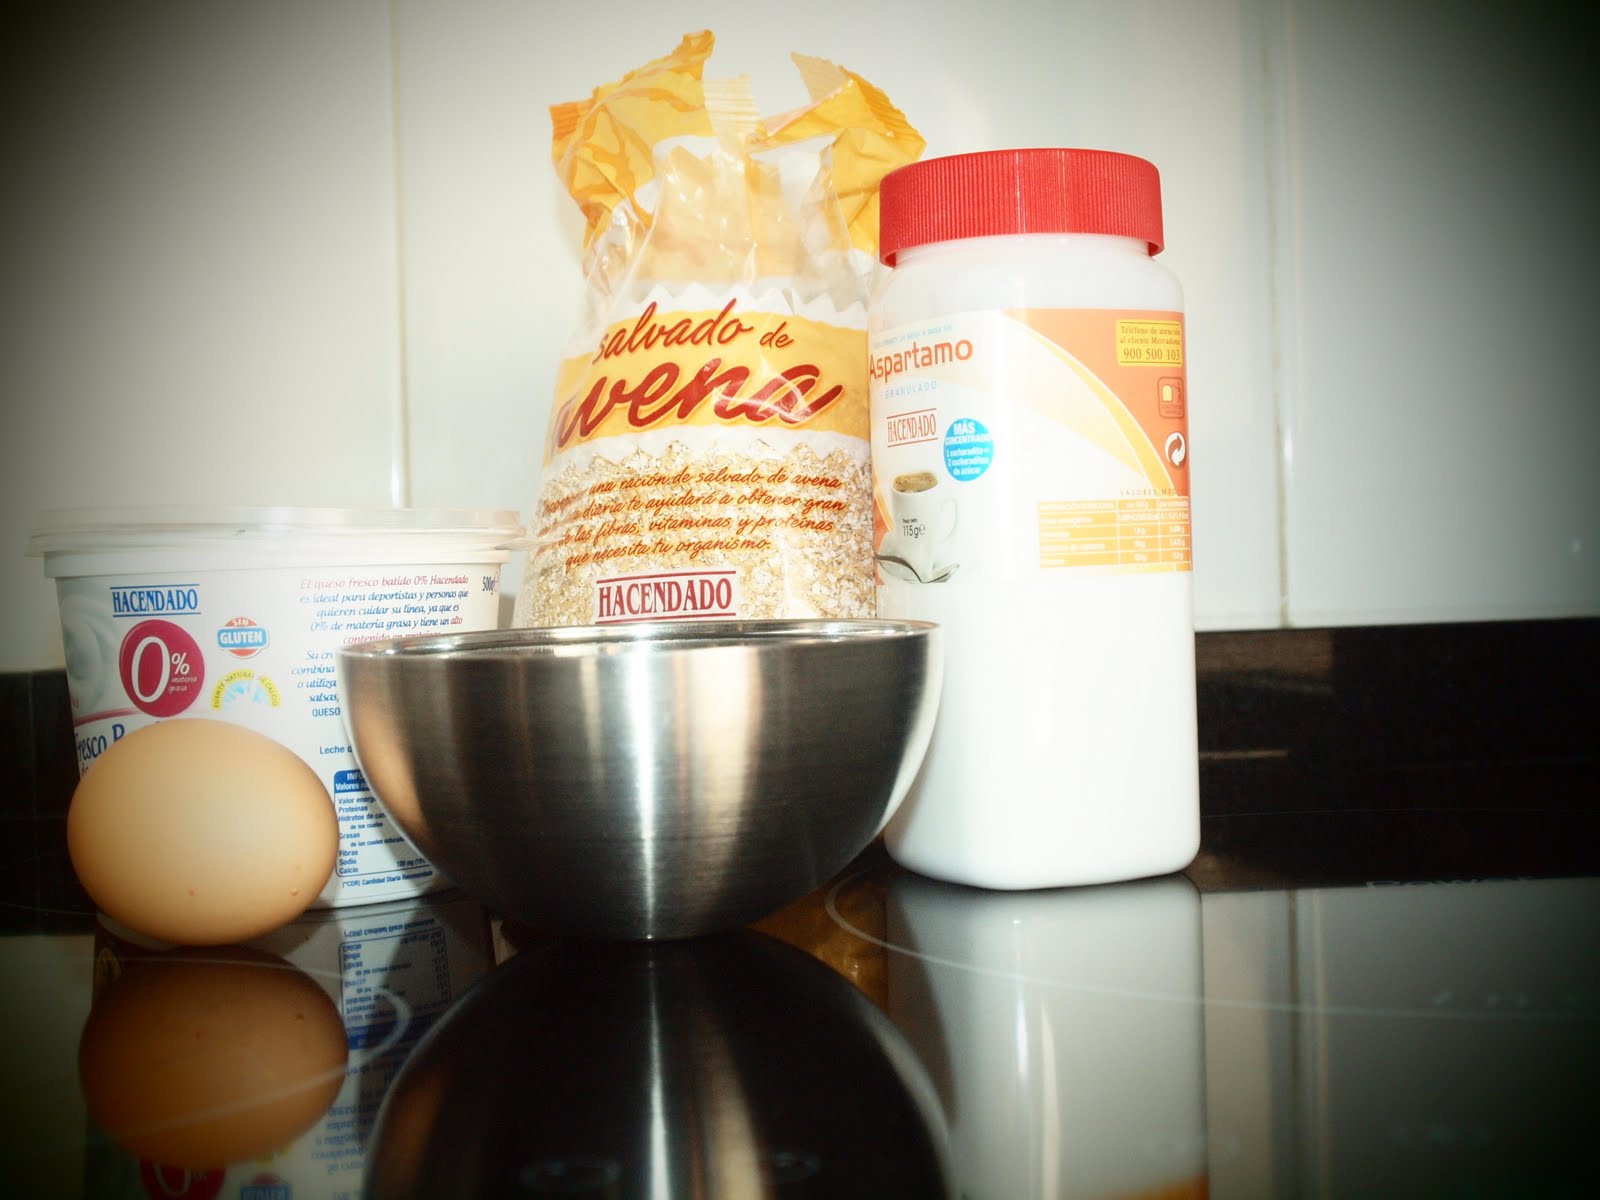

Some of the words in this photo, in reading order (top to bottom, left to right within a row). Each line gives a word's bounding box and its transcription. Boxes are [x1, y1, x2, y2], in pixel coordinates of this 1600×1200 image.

[593, 298, 754, 365] salvado
[759, 321, 794, 349] de
[870, 339, 973, 383] Aspartamo
[1123, 348, 1141, 359] 900
[1145, 348, 1162, 360] 500
[1167, 349, 1180, 361] 103
[885, 381, 937, 399] GRANULADO
[887, 413, 936, 443] HACENDADO
[954, 420, 976, 435] MÁS
[589, 482, 615, 495] una
[620, 473, 669, 490] ración
[672, 466, 692, 484] de
[695, 466, 762, 484] salvado
[767, 467, 788, 483] de
[790, 474, 842, 489] avena
[583, 501, 624, 519] diaria
[628, 496, 643, 510] te
[645, 489, 717, 515] ayudará
[719, 494, 732, 505] a
[802, 499, 846, 515] gran
[574, 525, 591, 542] las
[593, 519, 639, 546] fibras,
[649, 514, 731, 531] vitaminas
[736, 519, 750, 535] y
[565, 553, 591, 573] que
[593, 542, 650, 561] necesita
[652, 540, 673, 553] tu
[675, 537, 771, 560] organismo.
[314, 579, 345, 591] queso
[348, 577, 379, 589] fresco
[382, 576, 411, 586] batido
[414, 576, 428, 585] 0%
[430, 575, 468, 585] Hacendado
[112, 589, 198, 613] HACENDADO
[314, 593, 338, 603] ideal
[342, 594, 365, 605] para
[368, 591, 417, 603] deportistas
[418, 592, 424, 601] y
[426, 590, 457, 601] personas
[458, 590, 468, 600] que
[598, 578, 732, 618] HACENDADO
[317, 607, 356, 617] quieren
[359, 606, 389, 615] cuidar
[428, 605, 438, 614] ya
[439, 605, 451, 613] que
[452, 604, 459, 612] es
[310, 622, 327, 631] 0%
[331, 621, 343, 630] de
[346, 619, 384, 629] materia
[386, 619, 411, 630] grasa
[412, 619, 419, 628] y
[420, 616, 439, 626] tiene
[440, 618, 449, 626] un
[450, 616, 462, 625] alto
[219, 631, 263, 645] GLUTEN
[306, 651, 318, 660] Su
[172, 676, 197, 684] materia
[225, 672, 254, 683] NATURAL
[168, 685, 188, 693] grasa
[313, 708, 341, 717] QUESO
[319, 745, 345, 755] Leche
[336, 782, 359, 791] Valores
[338, 814, 364, 822] Hidratos
